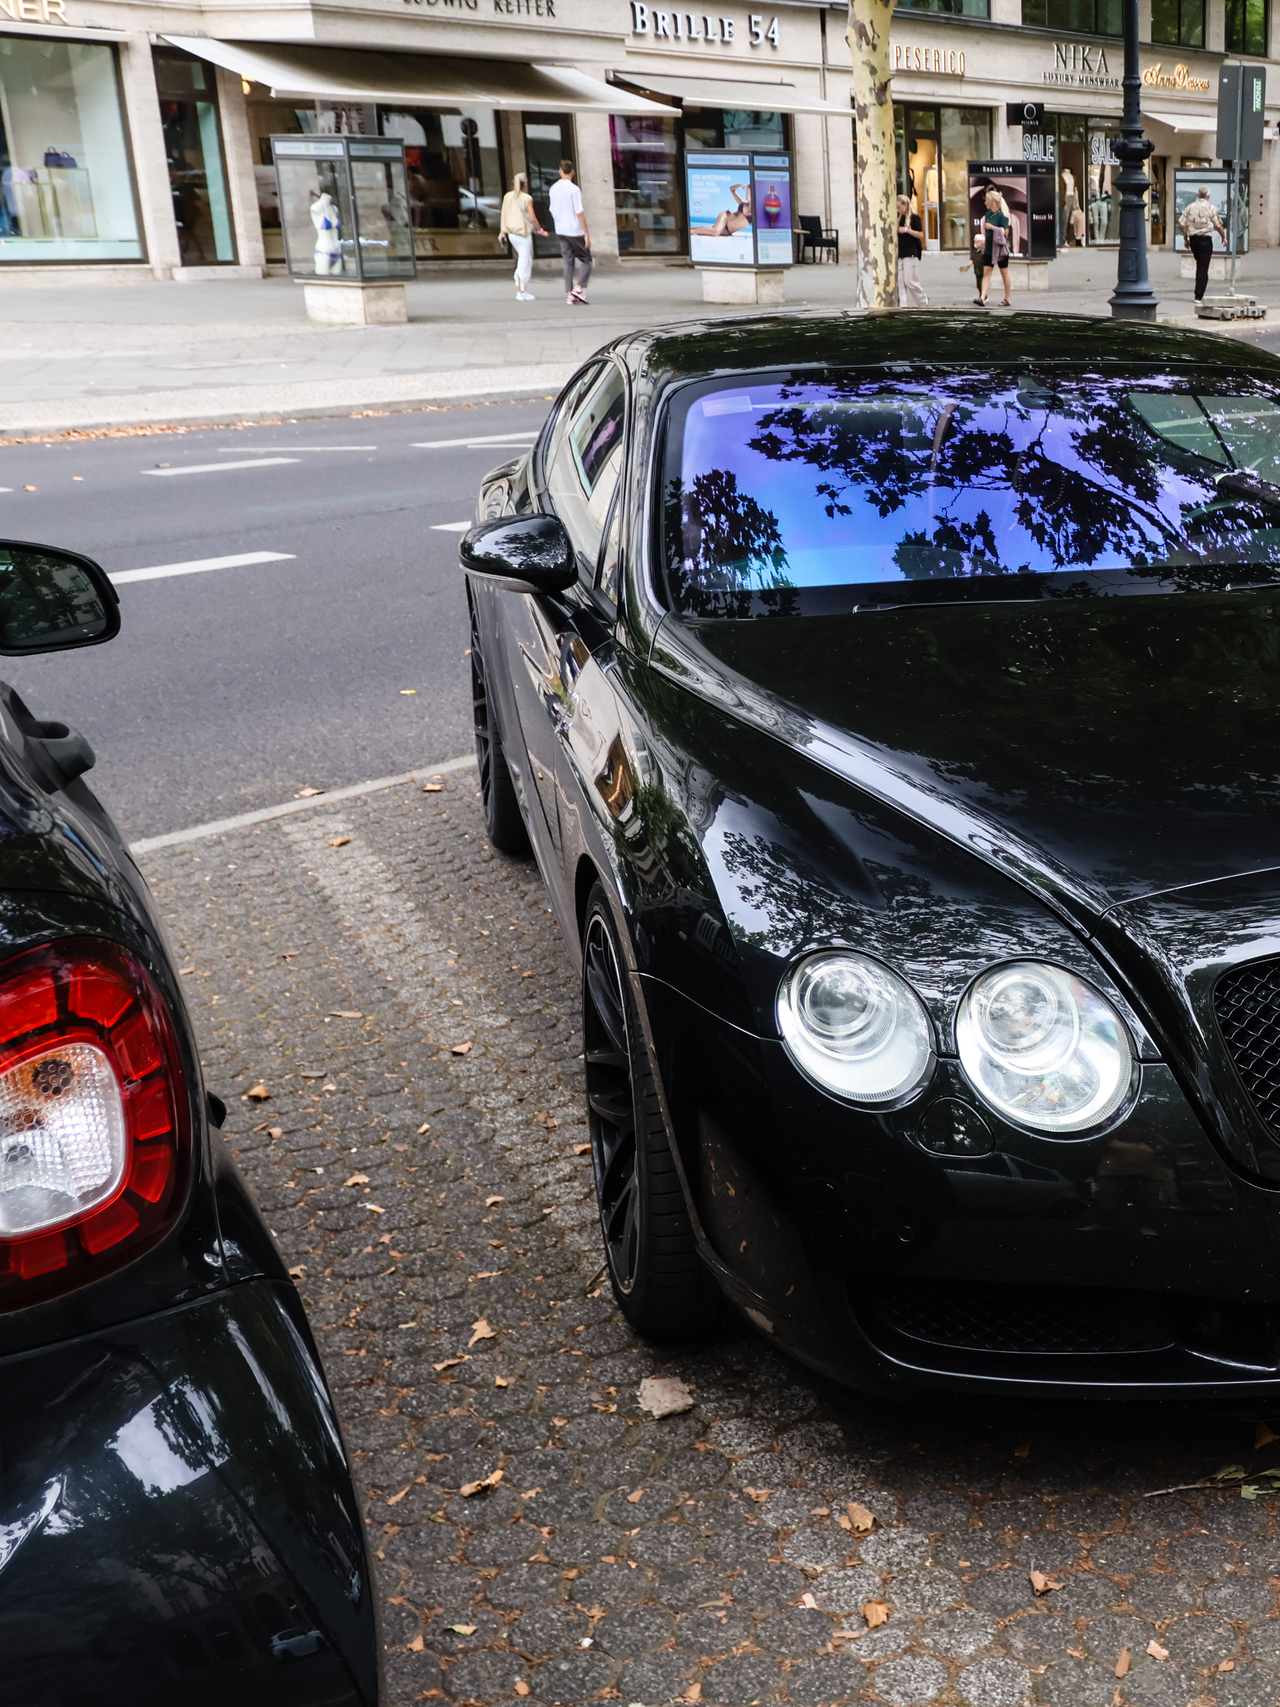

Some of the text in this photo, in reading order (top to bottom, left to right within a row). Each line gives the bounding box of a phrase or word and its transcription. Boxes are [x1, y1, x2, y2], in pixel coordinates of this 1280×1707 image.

[494, 0, 556, 17] REITER
[748, 14, 780, 46] 54
[894, 45, 966, 75] PESERICO
[1053, 43, 1109, 73] NIKA
[1042, 71, 1119, 88] LUXURY MENSWEAR
[1142, 63, 1177, 87] Anna
[1023, 133, 1055, 162] SALE
